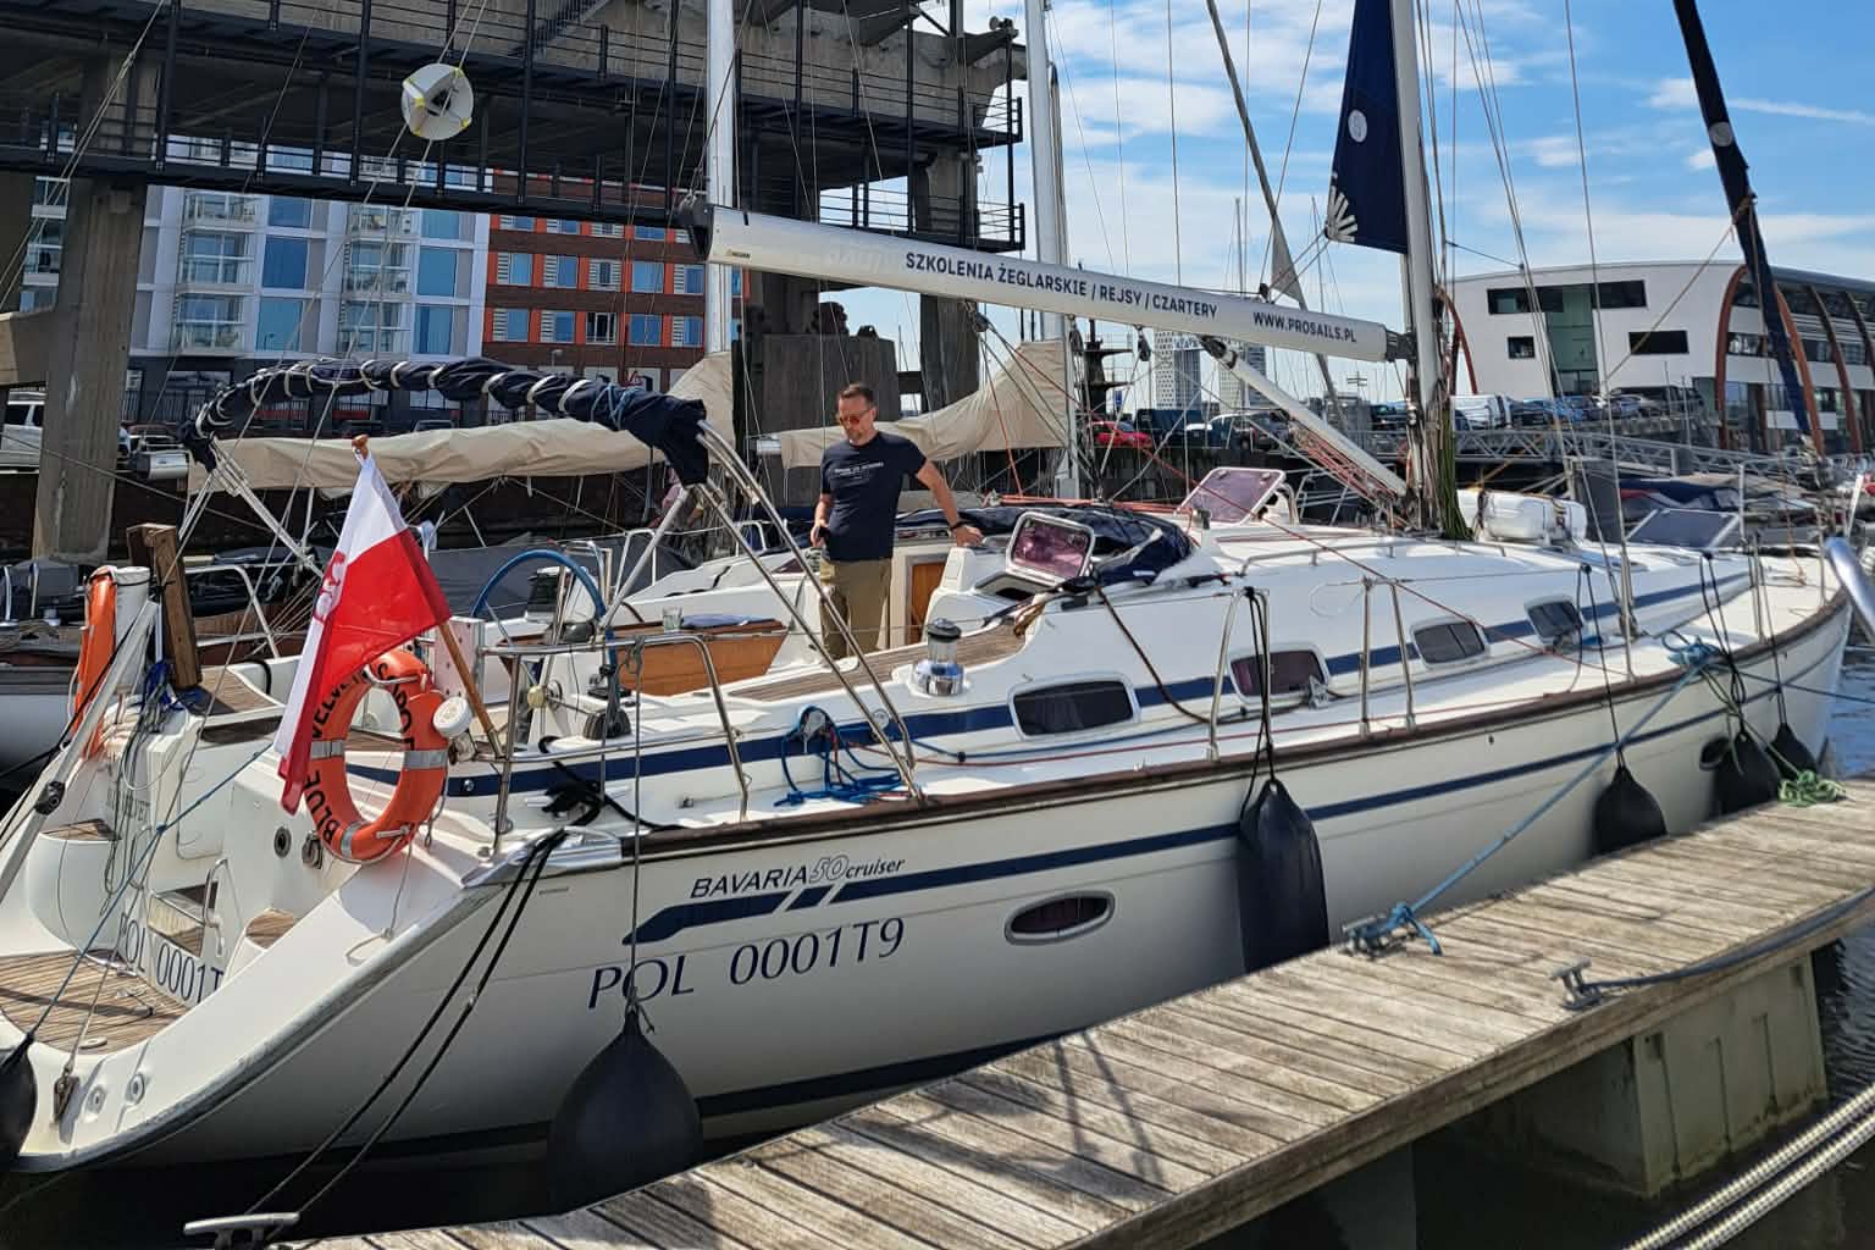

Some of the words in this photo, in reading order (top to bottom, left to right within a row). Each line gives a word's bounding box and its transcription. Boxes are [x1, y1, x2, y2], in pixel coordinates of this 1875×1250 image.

[906, 253, 994, 281] SZKOLENIA
[998, 262, 1087, 296] ŻEGLARSKIE
[1100, 285, 1142, 306] REJSY
[1152, 296, 1217, 319] CZARTERY
[1253, 311, 1357, 344] WWW.PROSAILS.PL
[305, 770, 340, 844] BLUE
[690, 865, 811, 900] BAVARIA
[810, 854, 848, 885] 50
[846, 857, 905, 880] cruiser
[589, 954, 694, 1009] POL
[730, 917, 905, 986] 0001T9
